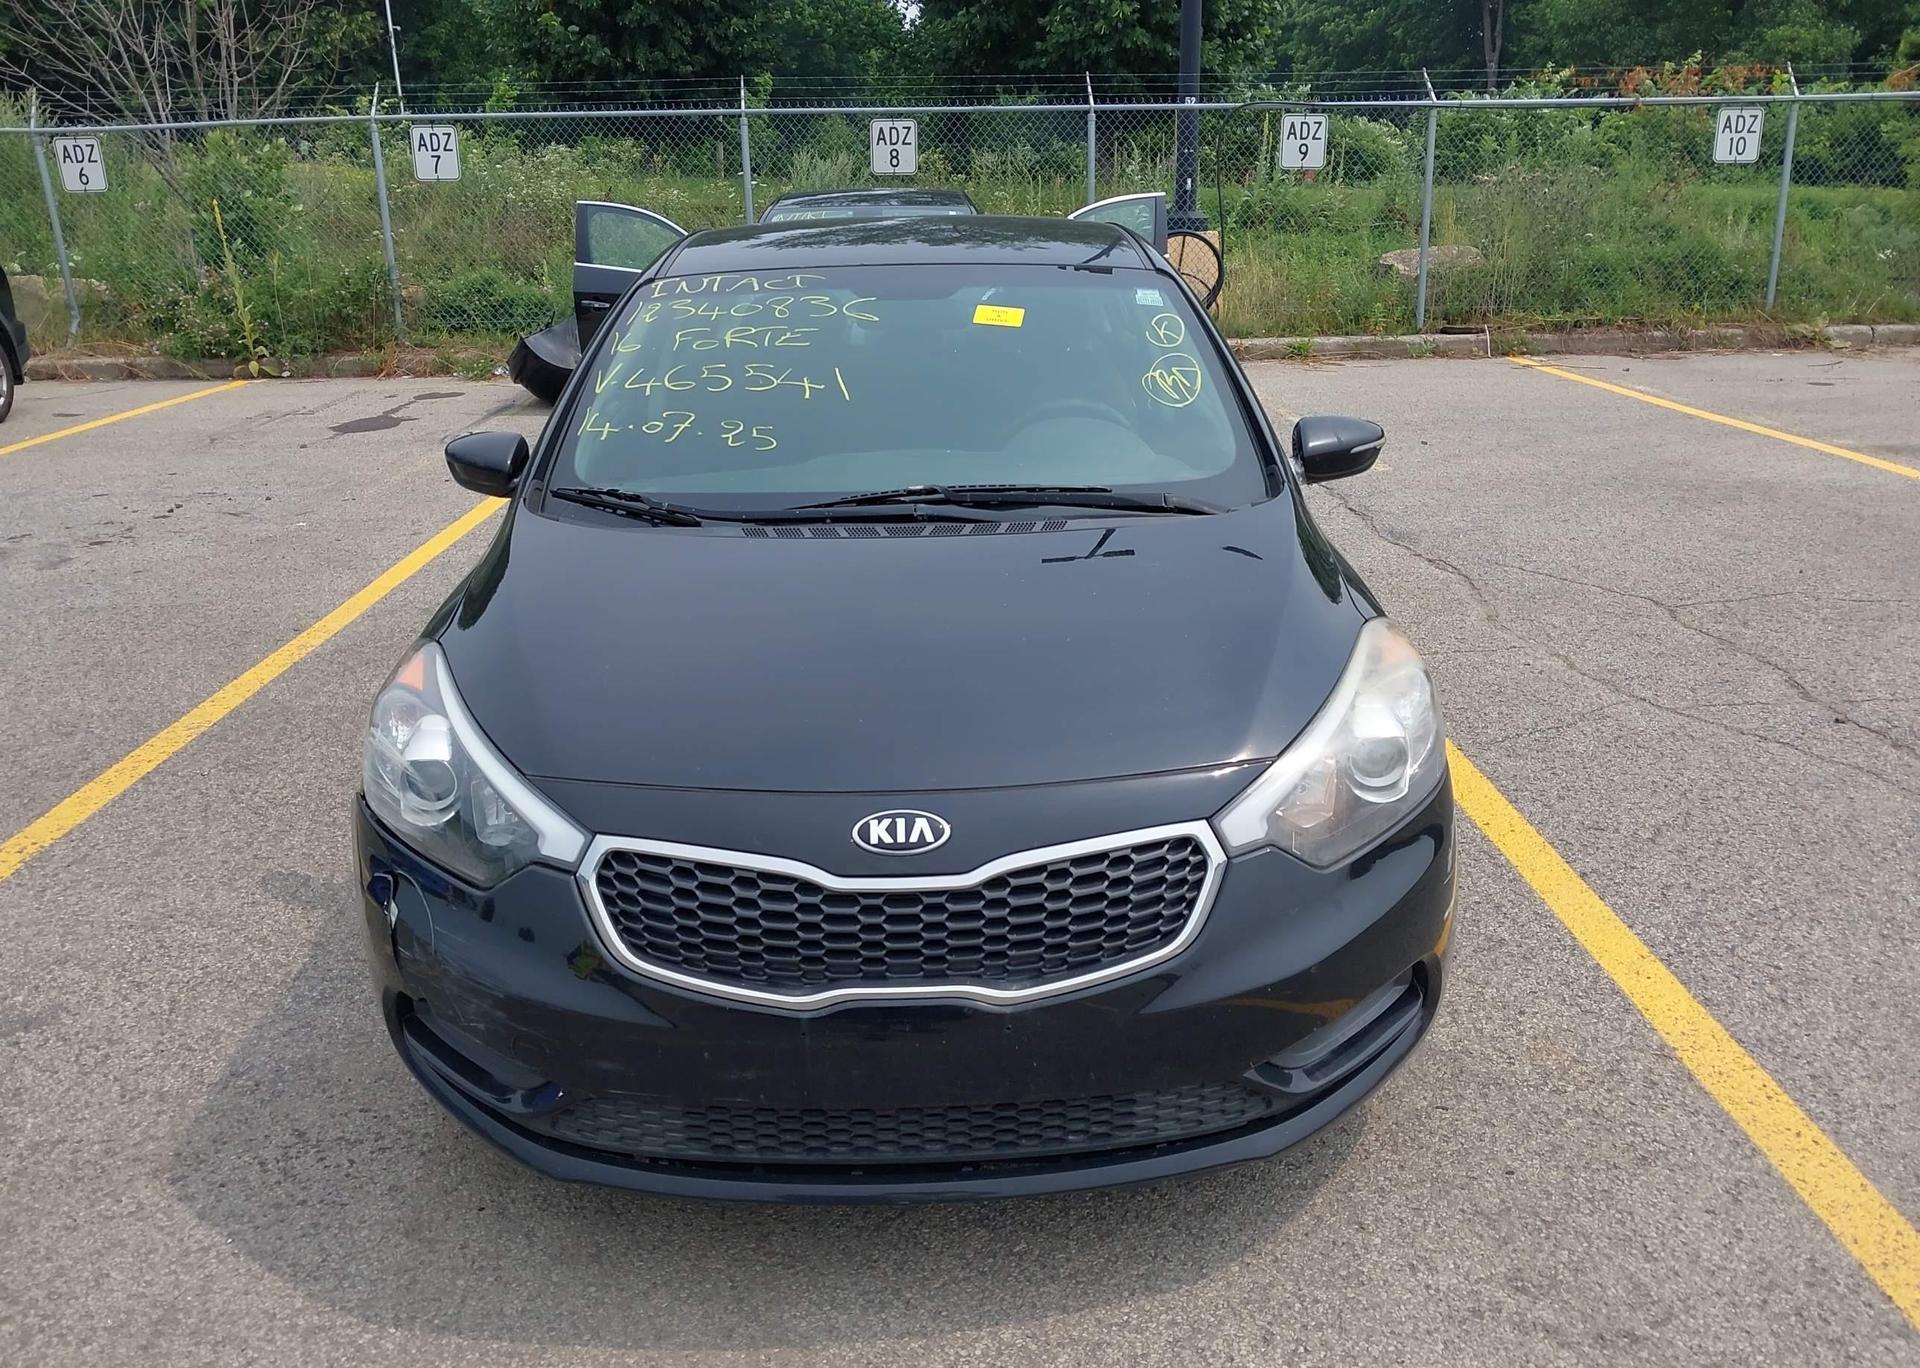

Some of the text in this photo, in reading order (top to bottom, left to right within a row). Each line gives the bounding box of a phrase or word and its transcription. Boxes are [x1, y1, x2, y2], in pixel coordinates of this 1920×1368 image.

[1286, 121, 1323, 141] ADZ
[1722, 115, 1759, 134] ADZ
[418, 132, 454, 152] ADZ
[876, 126, 912, 146] ADZ
[1729, 136, 1747, 156] 10
[63, 144, 98, 164] ADZ
[889, 148, 900, 168] 8
[1298, 143, 1309, 162] 9
[430, 155, 441, 174] 7
[79, 166, 89, 185] 6
[651, 275, 826, 297] INTACT
[627, 297, 880, 325] 12340836
[673, 326, 819, 352] FORTE
[869, 818, 935, 844] KIA
